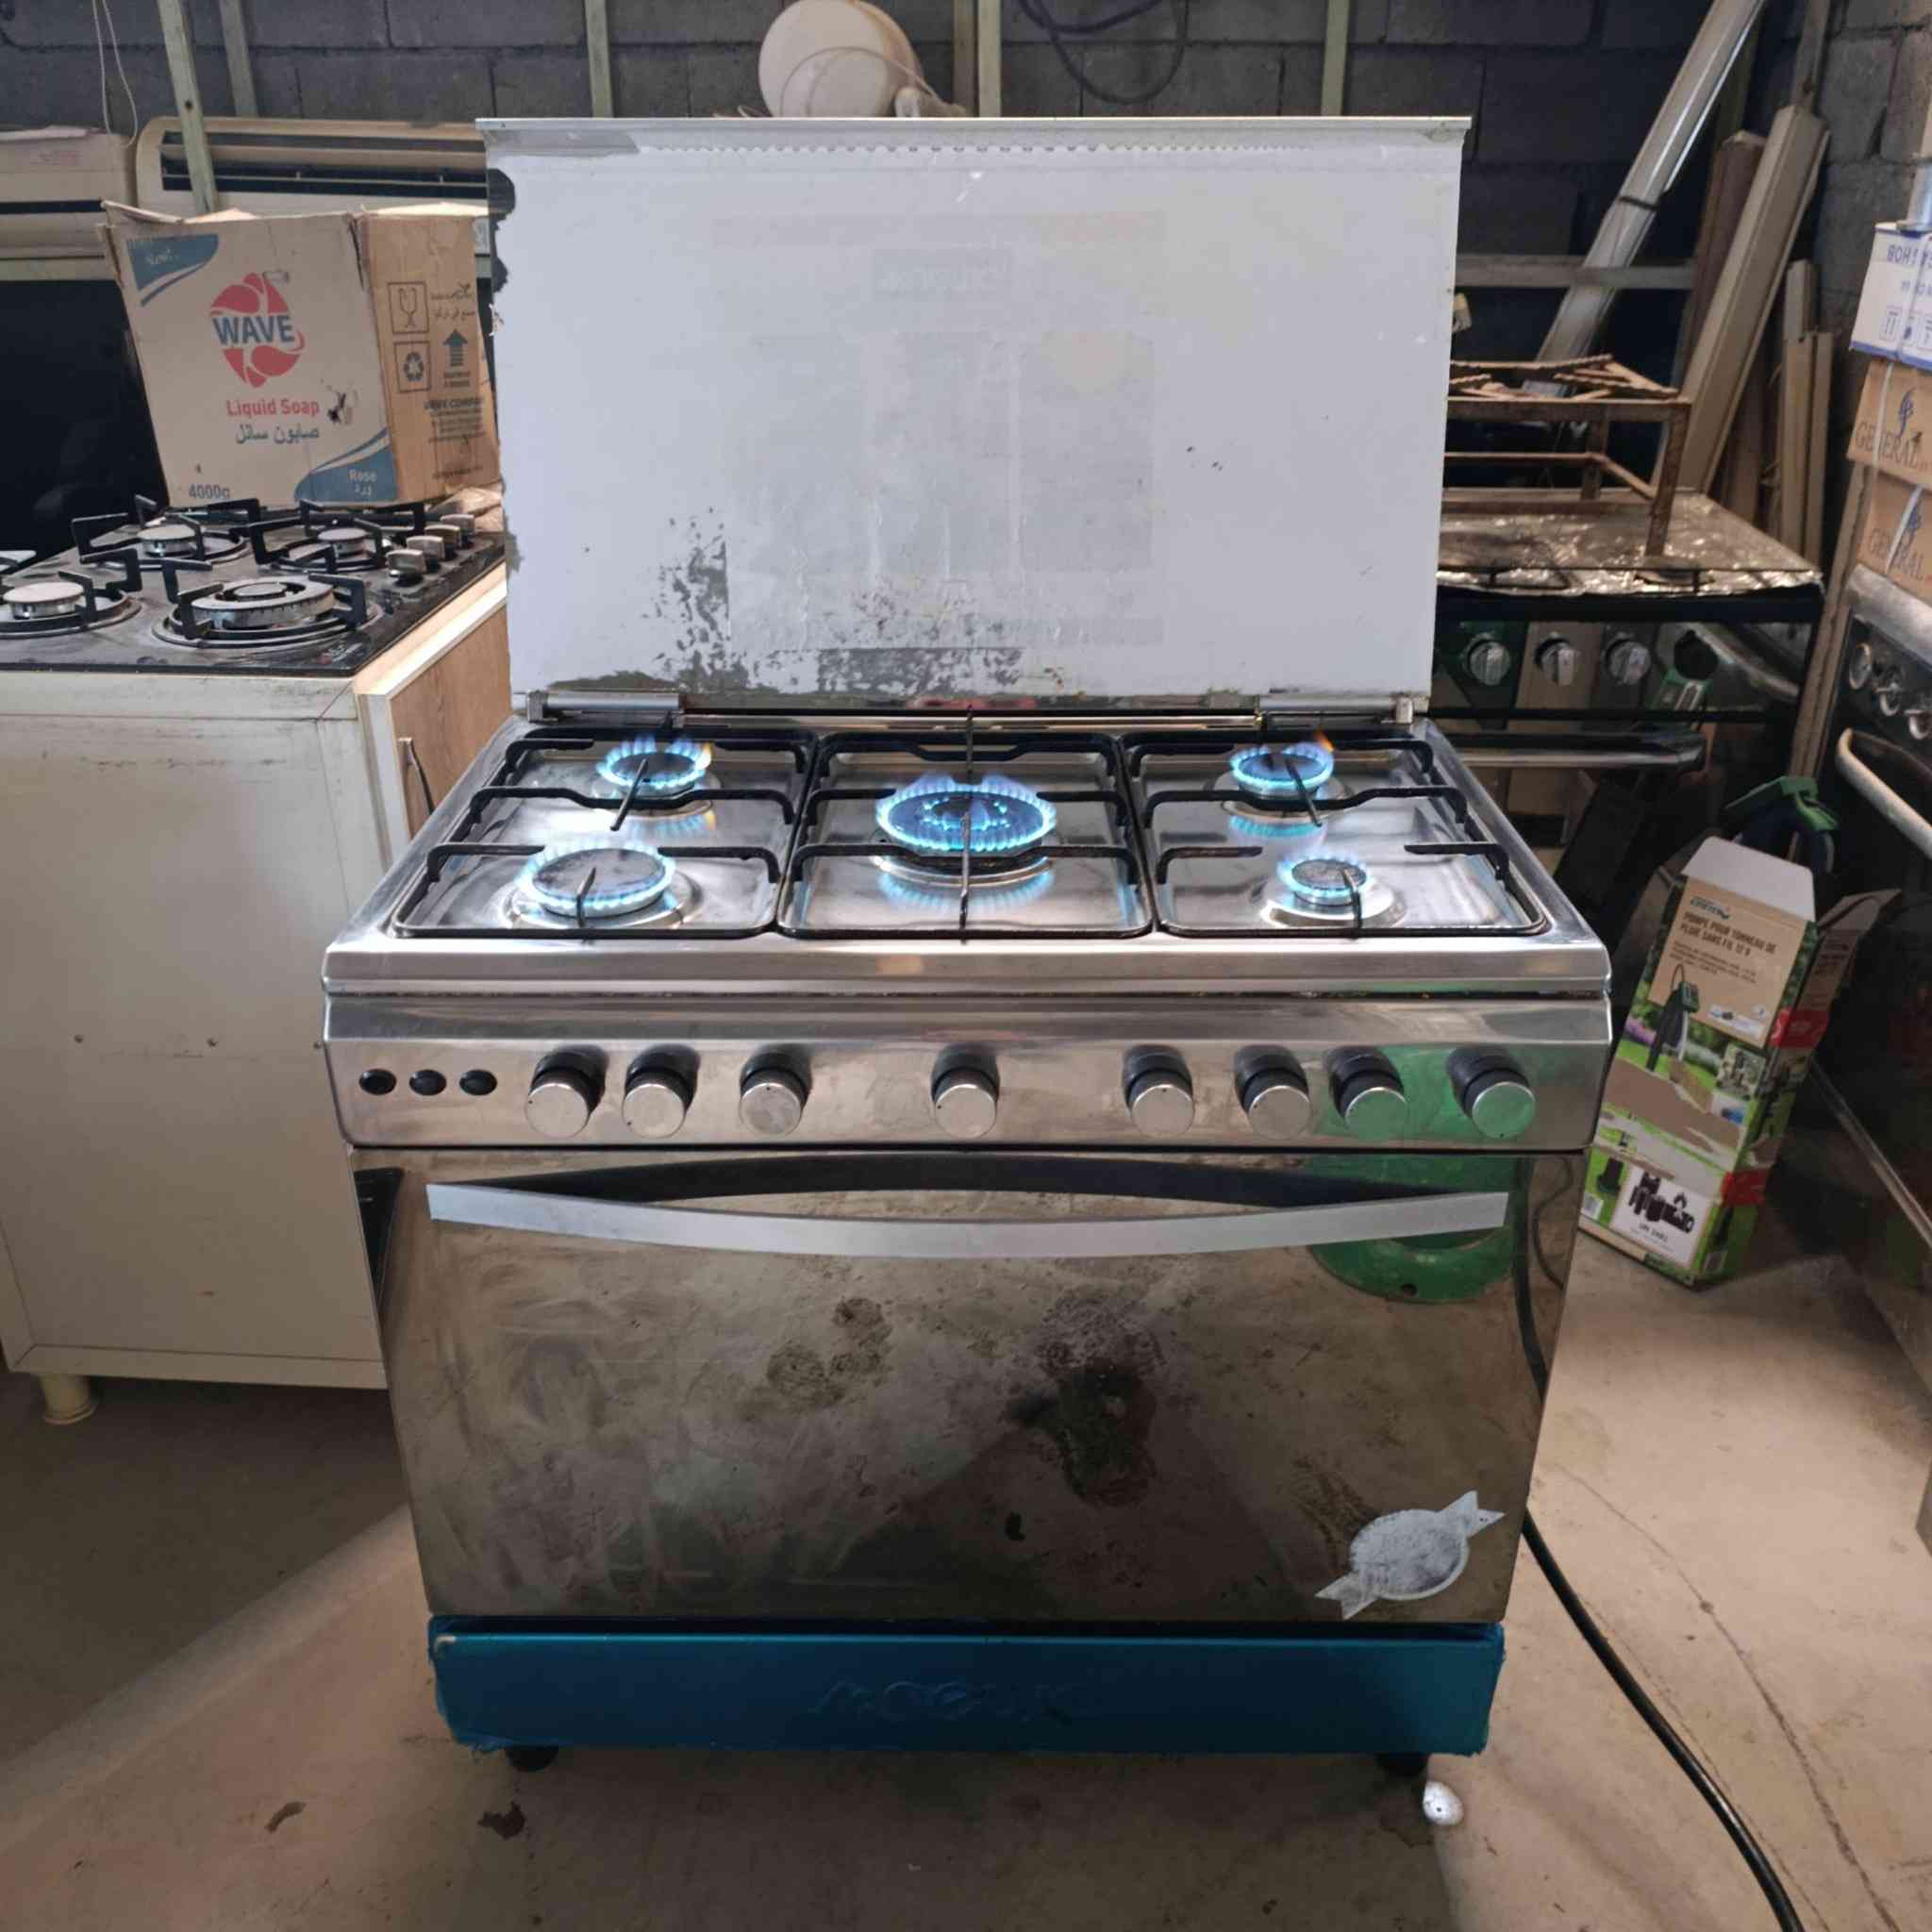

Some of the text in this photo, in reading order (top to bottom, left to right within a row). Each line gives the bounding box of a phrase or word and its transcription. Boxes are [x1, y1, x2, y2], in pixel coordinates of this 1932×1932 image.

[212, 315, 294, 345] WAVE
[226, 398, 320, 419] Liquid Soap
[273, 424, 320, 444] صابون
[349, 468, 377, 483] Rose
[189, 483, 231, 499] 4000g
